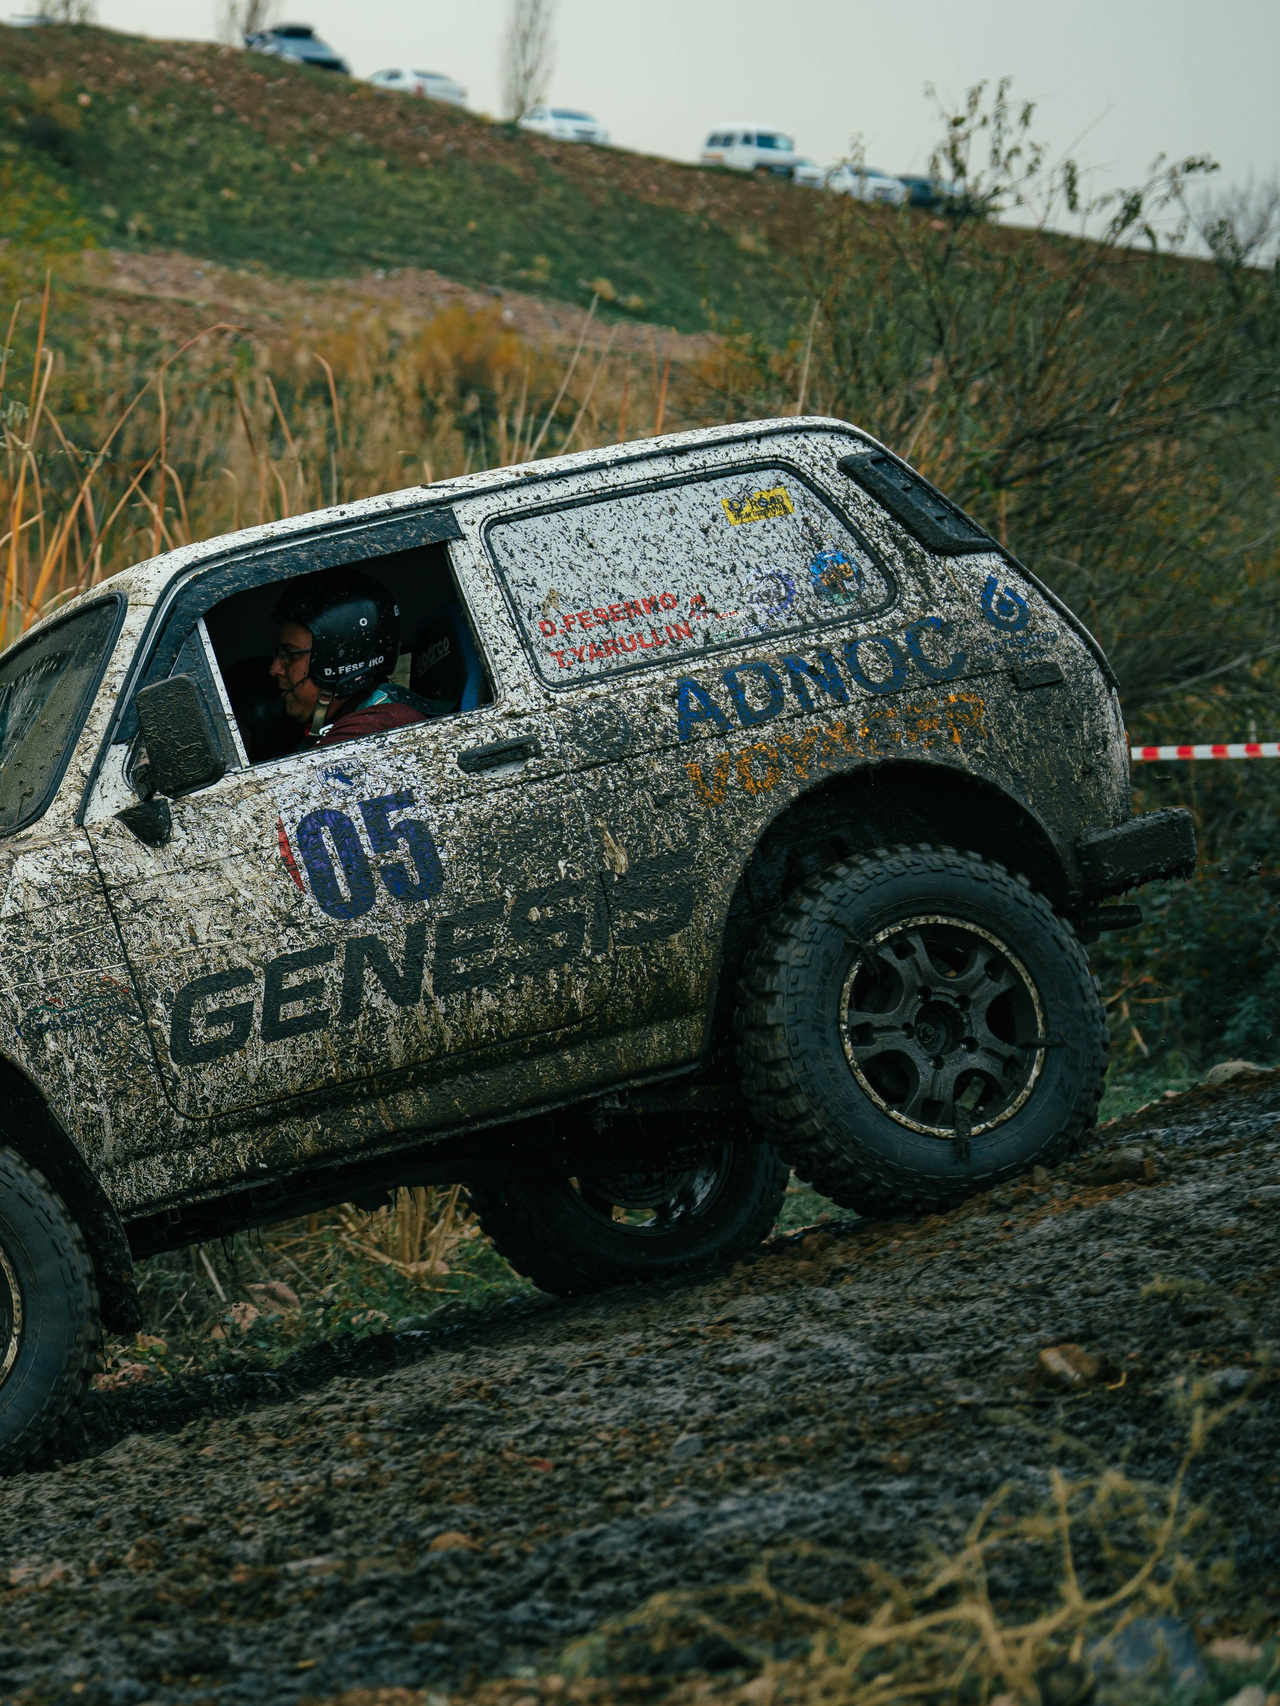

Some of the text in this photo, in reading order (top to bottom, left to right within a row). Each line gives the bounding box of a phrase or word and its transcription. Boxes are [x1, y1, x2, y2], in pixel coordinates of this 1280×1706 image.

[324, 667, 336, 676] D.
[550, 620, 694, 669] T.YARULLIN
[675, 616, 966, 742] ADNOC
[295, 790, 445, 920] 05
[169, 851, 696, 1067] GENESIS
